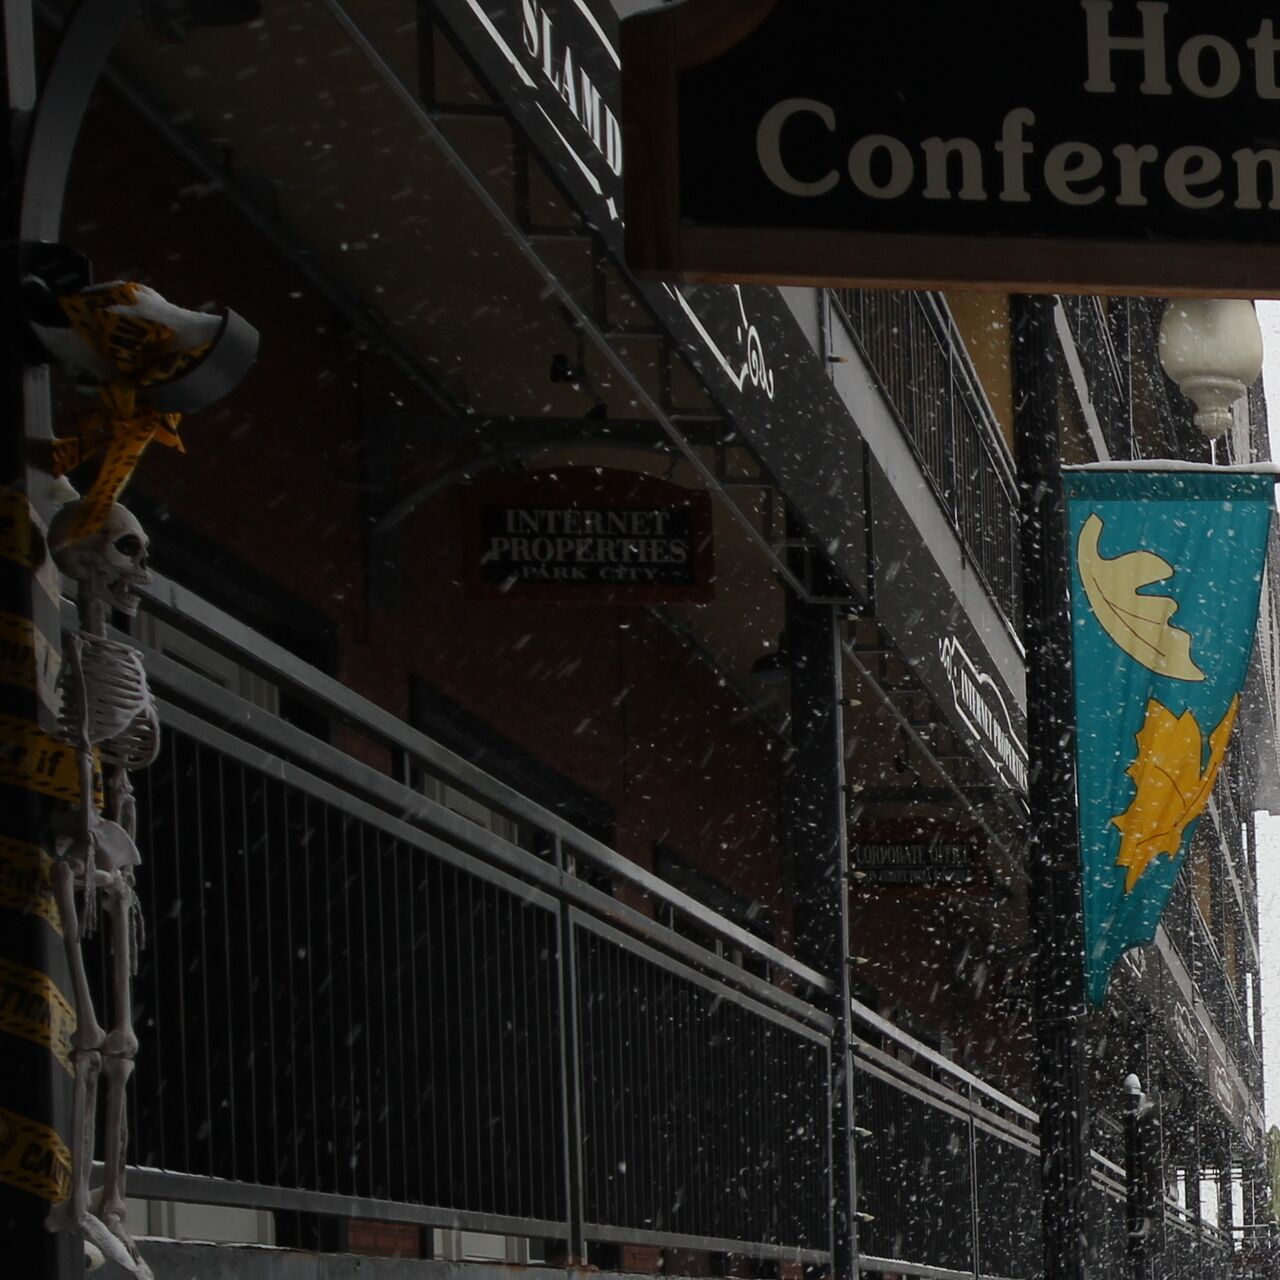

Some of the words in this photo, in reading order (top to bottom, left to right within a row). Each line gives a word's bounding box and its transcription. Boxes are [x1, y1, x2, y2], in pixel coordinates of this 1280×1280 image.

[505, 508, 670, 536] INTERNET
[490, 536, 689, 564] PROPERTIES
[520, 566, 589, 580] PARK
[598, 566, 660, 581] CITY
